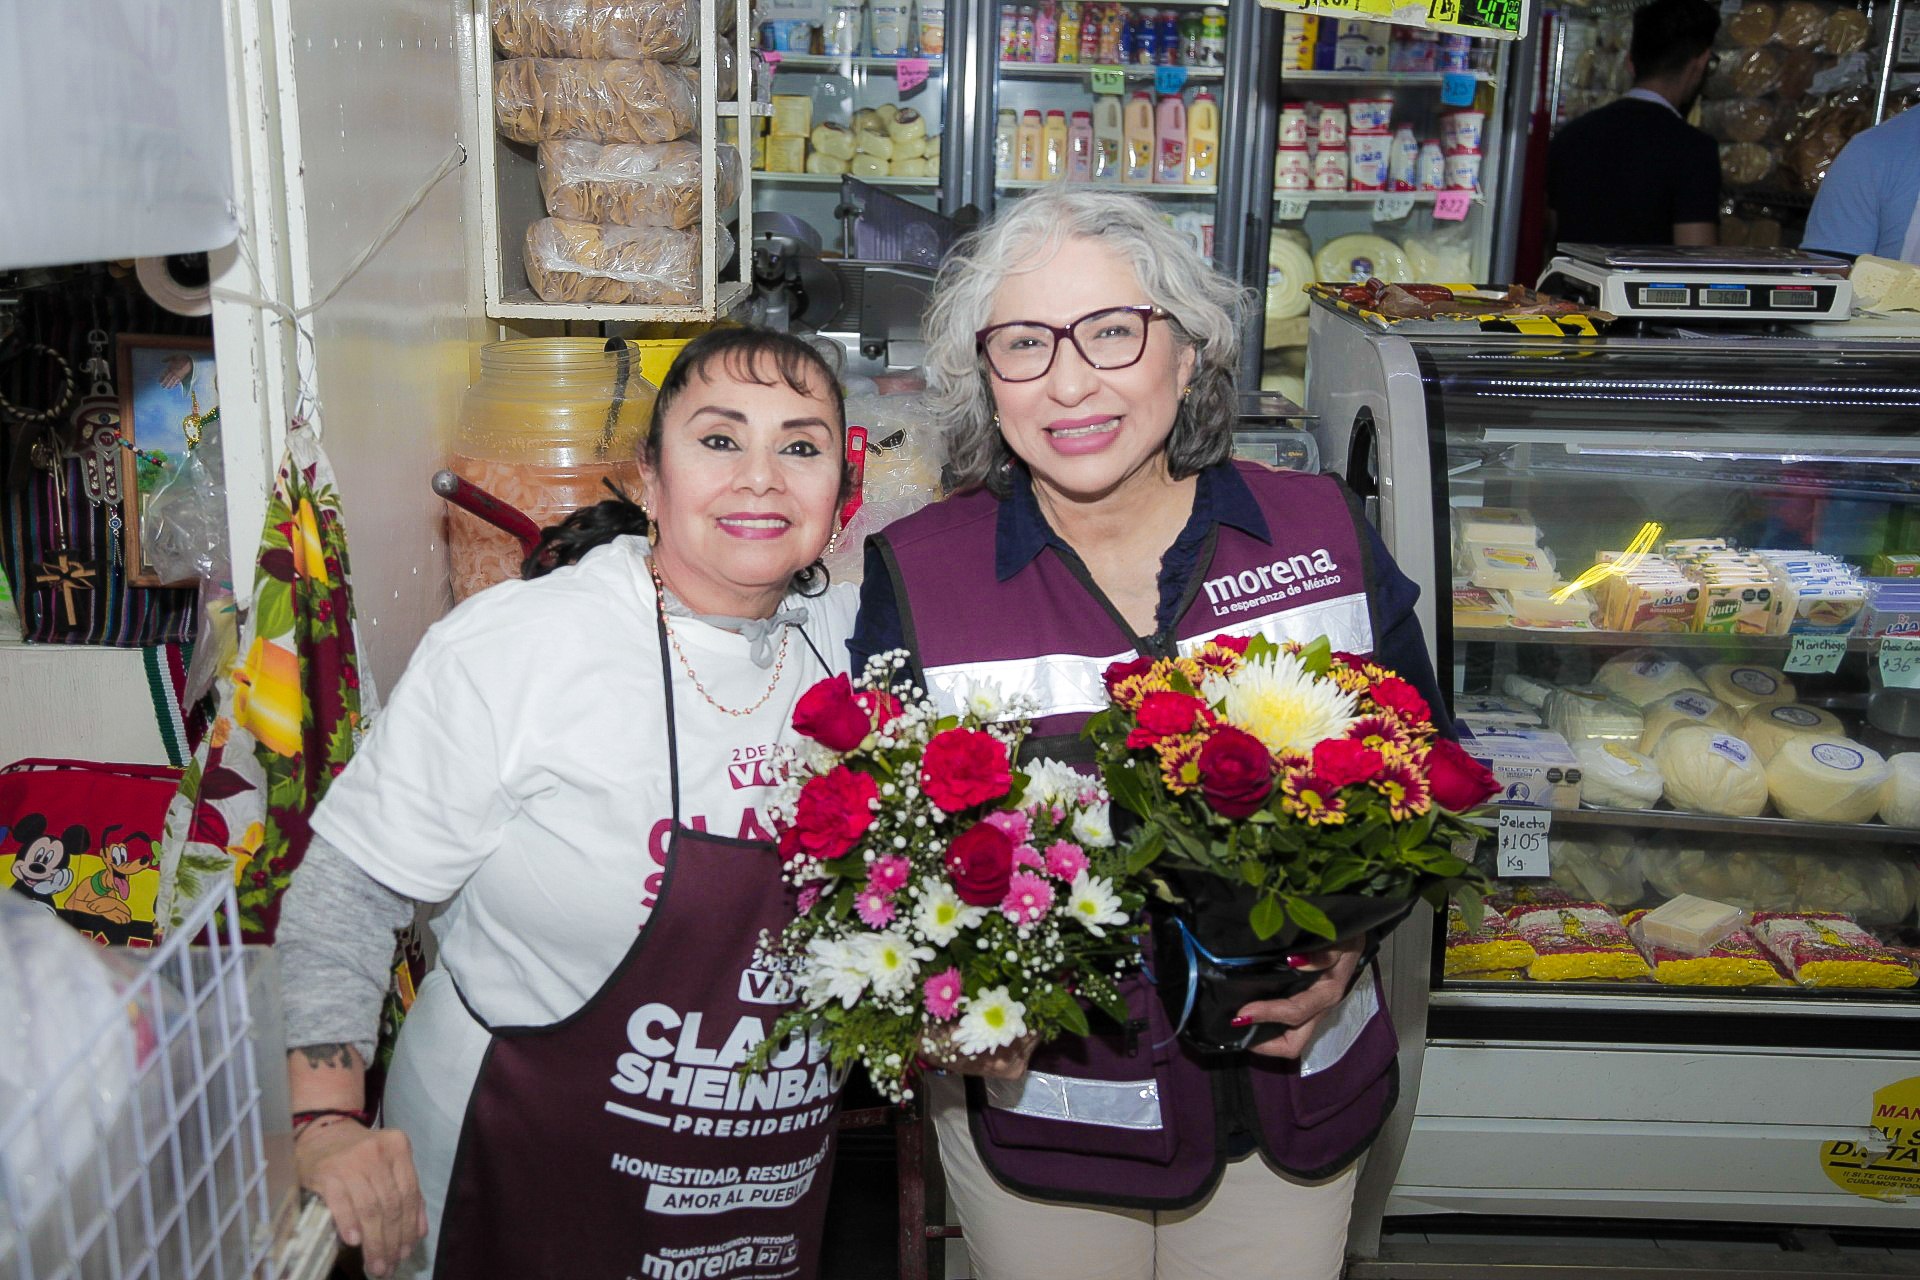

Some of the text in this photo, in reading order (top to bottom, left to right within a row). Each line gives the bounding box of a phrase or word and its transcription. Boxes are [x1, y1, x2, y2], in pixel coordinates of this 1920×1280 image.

[1203, 549, 1338, 605] morena
[1213, 573, 1341, 616] La esperanza de México
[1708, 601, 1742, 617] Nutri
[1886, 621, 1919, 635] LALA
[1796, 640, 1846, 654] Manchego
[1883, 657, 1911, 673] $36
[733, 749, 741, 761] 2
[746, 745, 767, 759] DE
[1498, 765, 1542, 774] SELECTA
[1500, 815, 1546, 829] Selecta
[1502, 833, 1540, 851] $105
[626, 1002, 833, 1069] CLAUD
[1876, 1104, 1920, 1120] MAN
[672, 1105, 830, 1137] PRESIDENTA
[611, 1153, 741, 1185] HONESTIDAD,
[663, 1193, 720, 1209] AMOR
[724, 1189, 744, 1206] AL
[641, 1246, 754, 1280] morena
[758, 1253, 777, 1263] PT
